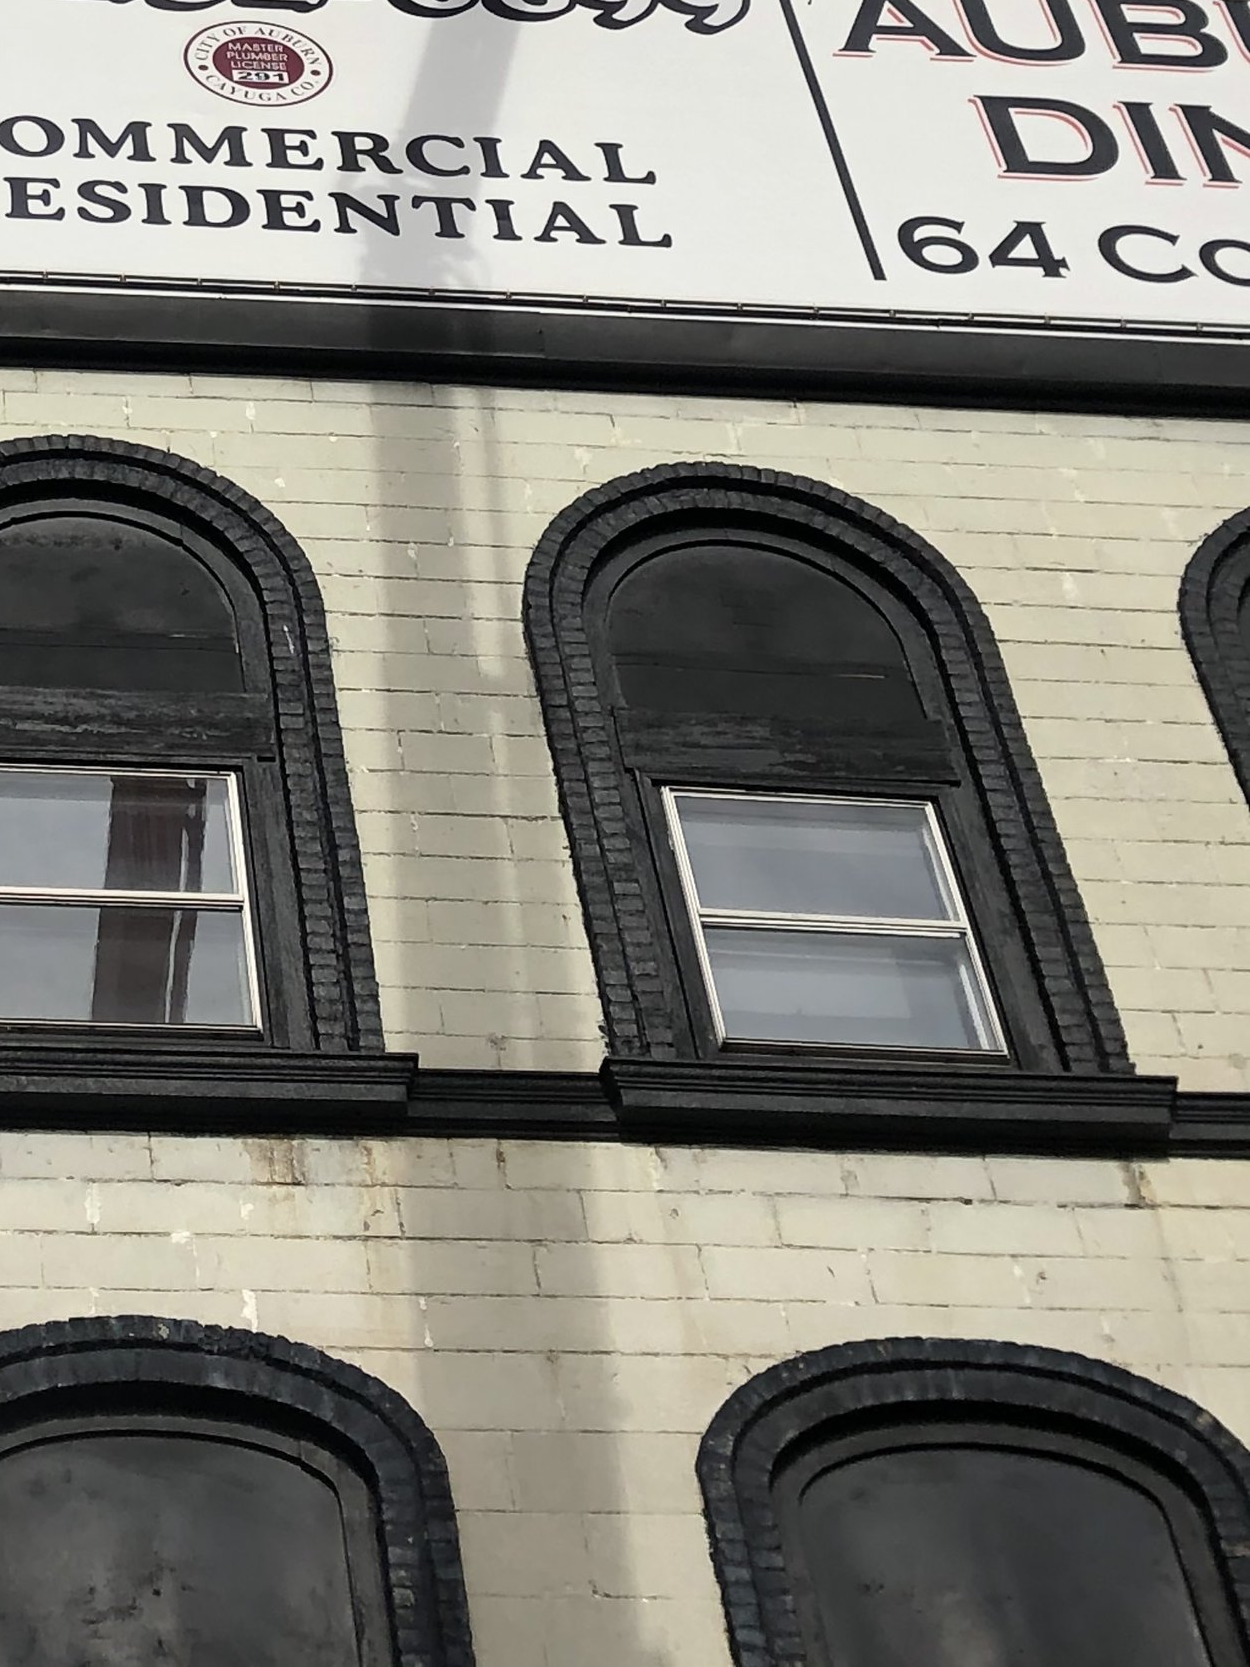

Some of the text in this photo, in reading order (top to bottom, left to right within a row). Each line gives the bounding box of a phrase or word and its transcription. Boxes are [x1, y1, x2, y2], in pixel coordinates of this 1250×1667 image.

[194, 26, 323, 68] CITY OF AUBURN
[227, 41, 284, 53] MASTER
[226, 50, 288, 62] PLUMBER
[230, 60, 287, 71] LICENSE
[237, 70, 285, 82] 291
[205, 74, 287, 102] CAYUGA
[897, 214, 1070, 279] 64
